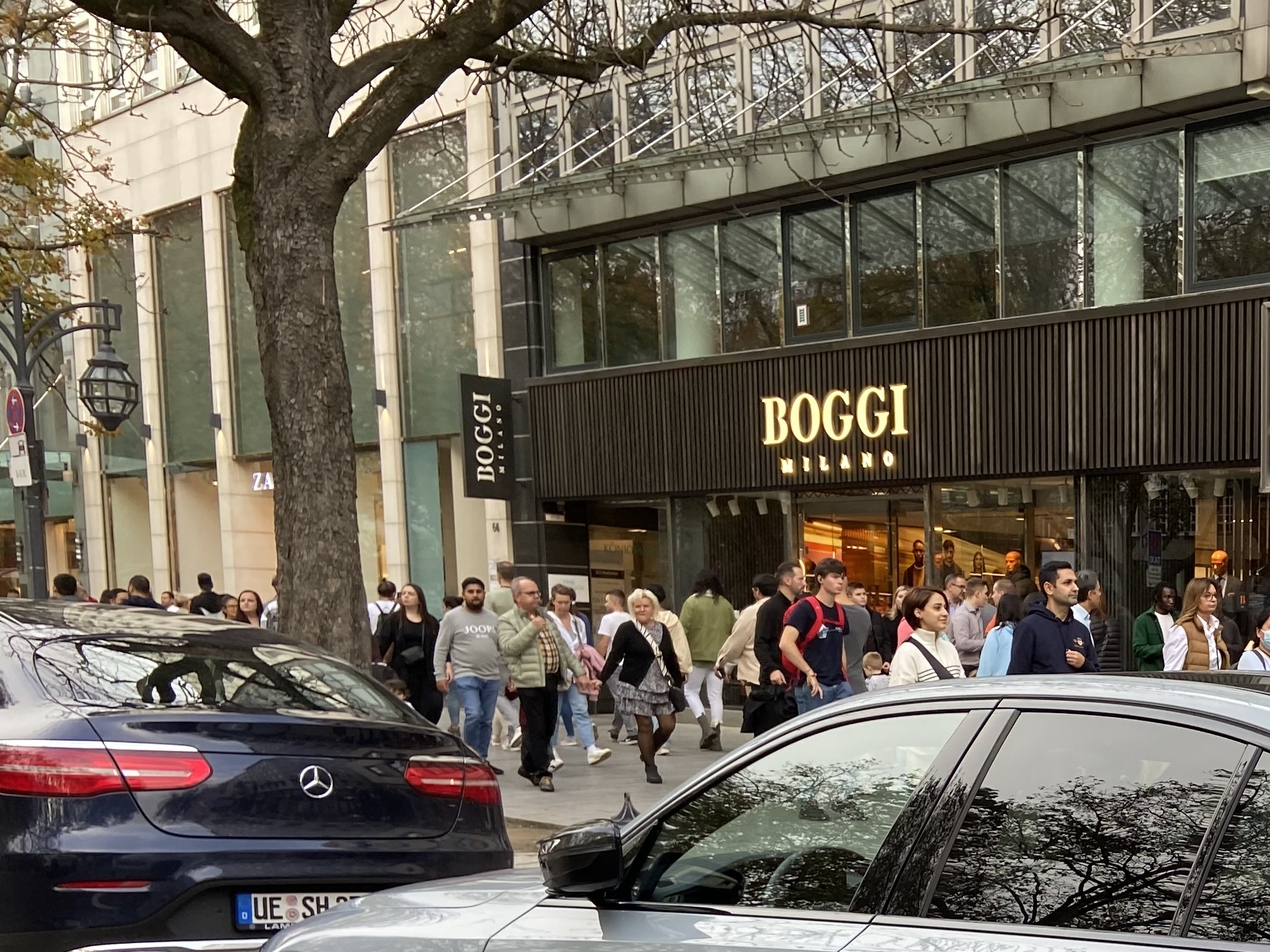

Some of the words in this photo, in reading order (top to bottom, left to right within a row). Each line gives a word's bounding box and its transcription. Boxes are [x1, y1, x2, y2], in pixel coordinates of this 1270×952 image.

[472, 391, 496, 483] BOGGI
[495, 404, 505, 474] MILANO
[761, 383, 908, 445] BOGGI
[779, 450, 895, 474] MILANO
[241, 911, 248, 920] D
[253, 896, 283, 920] UE
